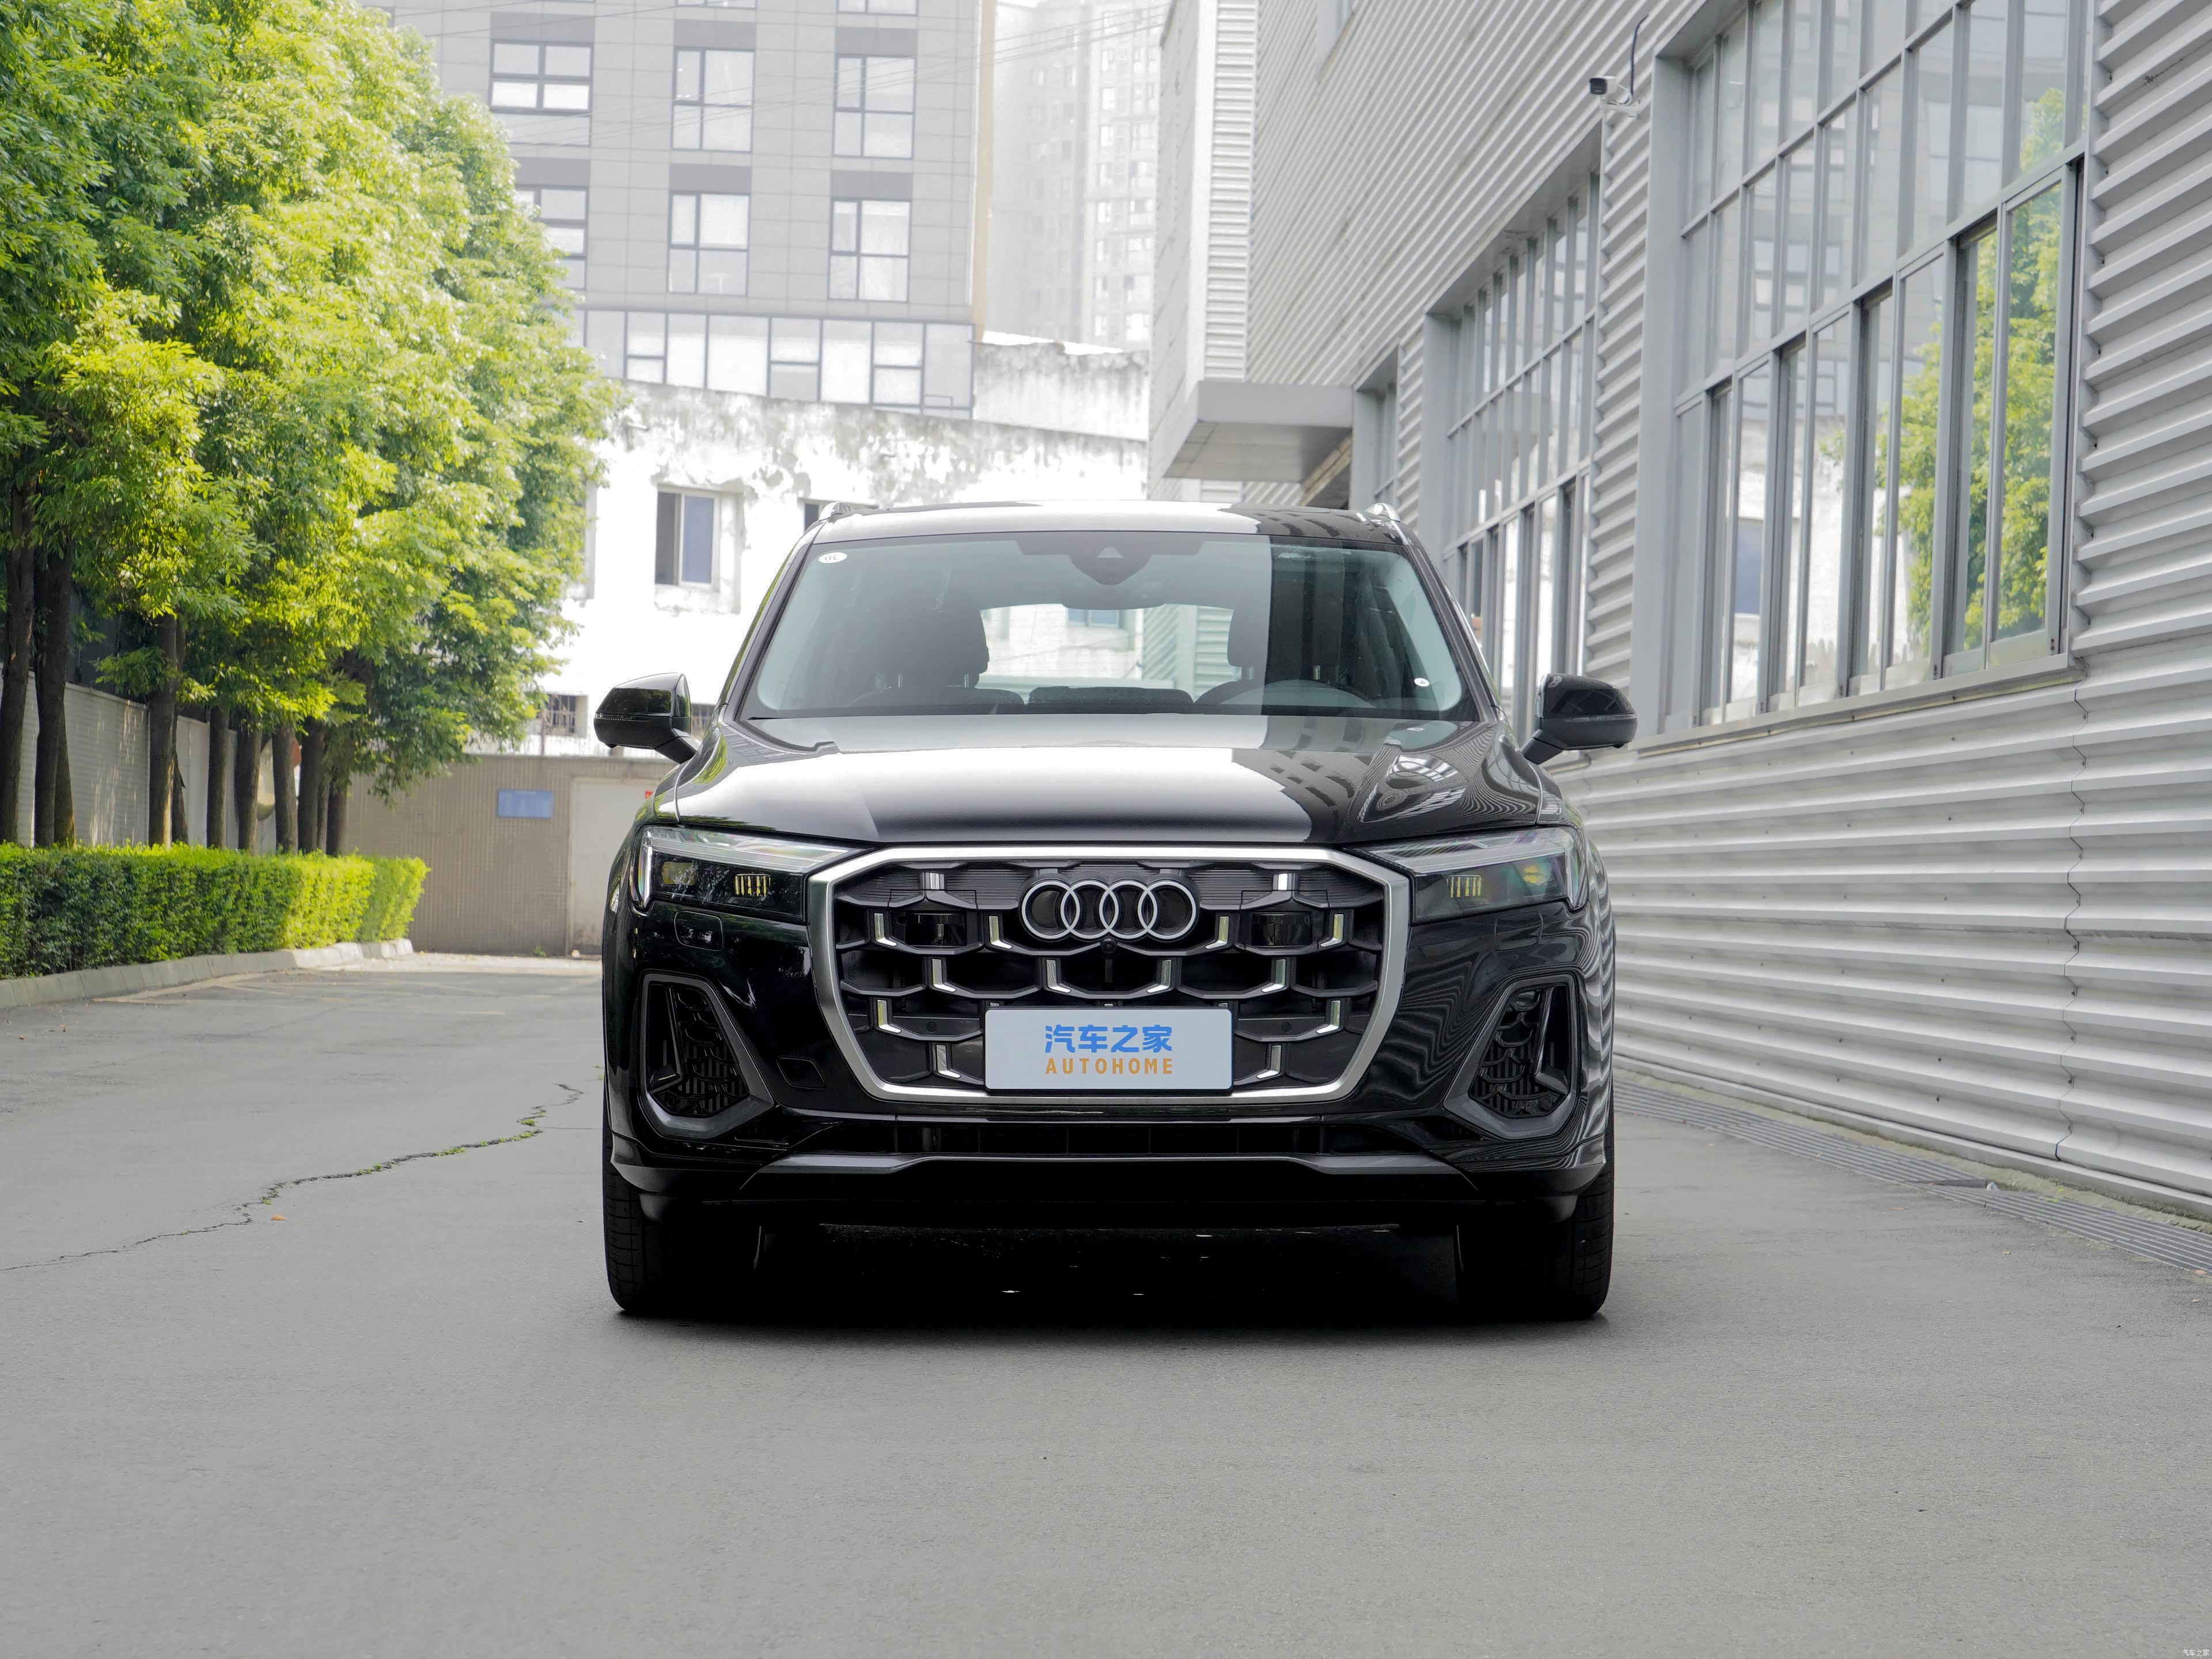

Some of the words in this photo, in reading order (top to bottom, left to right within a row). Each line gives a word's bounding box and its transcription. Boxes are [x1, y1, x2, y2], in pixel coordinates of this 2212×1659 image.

[1045, 1024, 1172, 1053] 汽车之家
[1045, 1058, 1173, 1074] AUTOHOME
